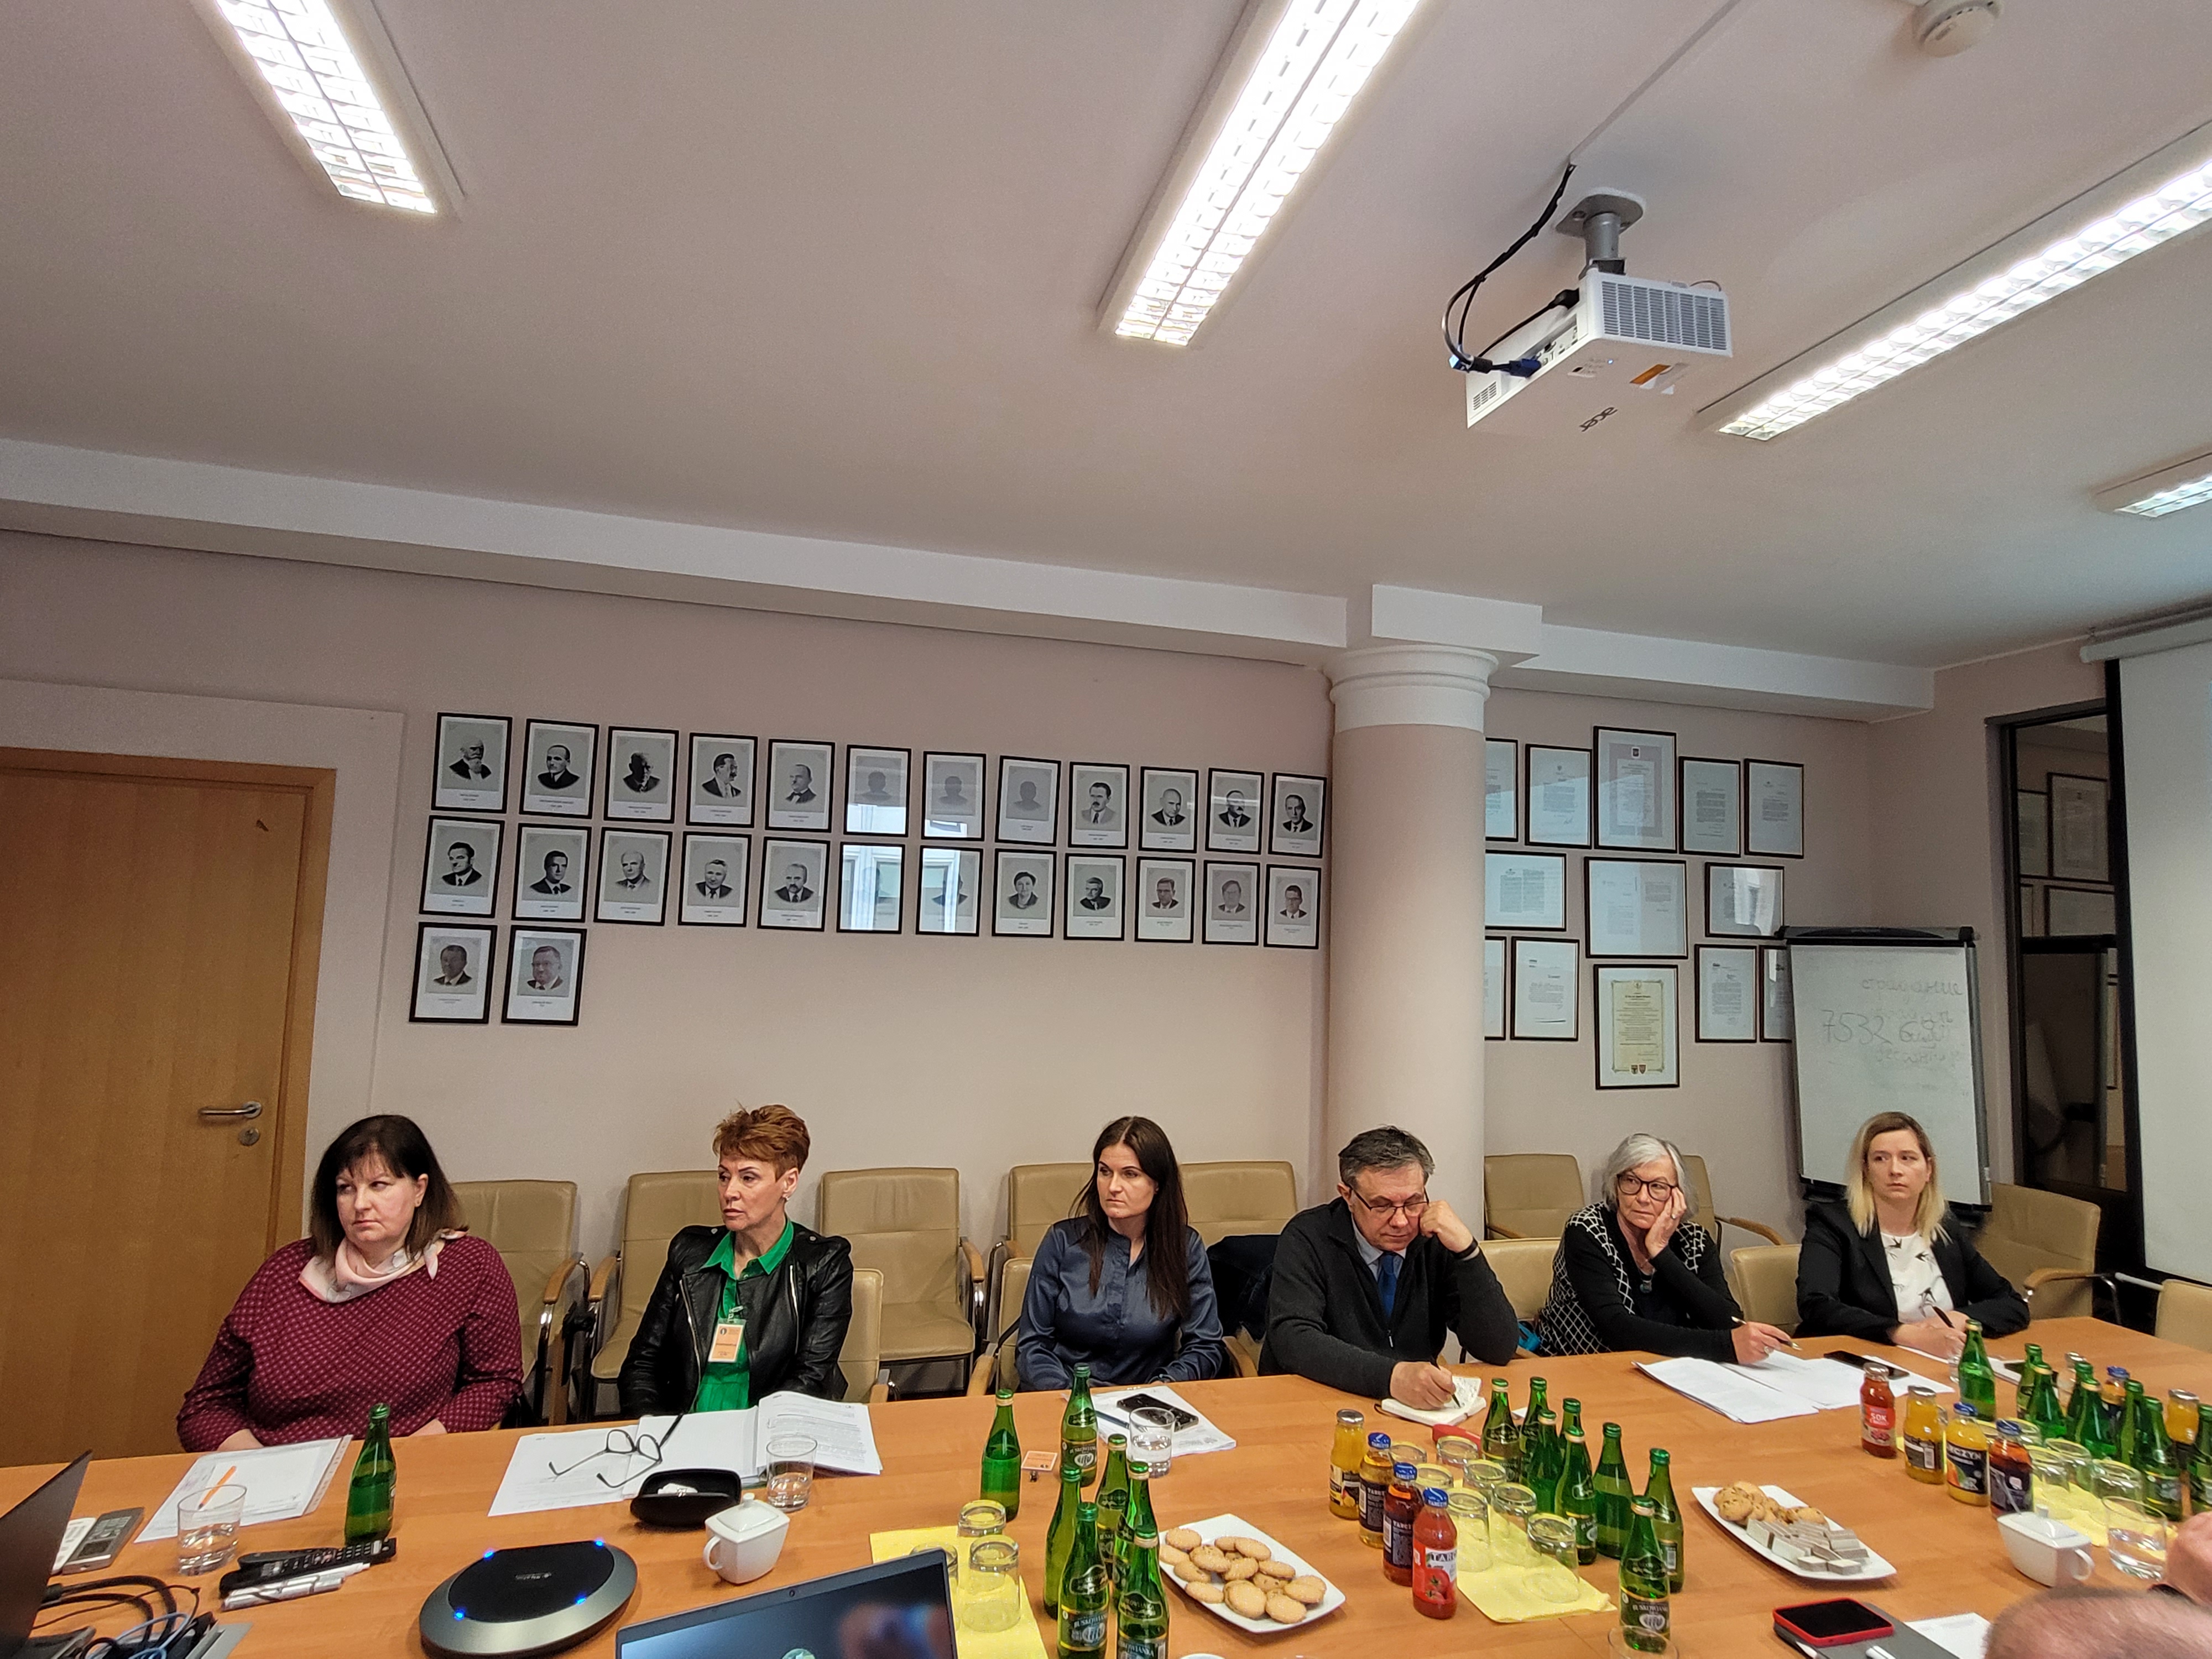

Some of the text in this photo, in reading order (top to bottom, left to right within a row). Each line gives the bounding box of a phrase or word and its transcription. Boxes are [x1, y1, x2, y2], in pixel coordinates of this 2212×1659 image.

[1579, 406, 1618, 432] acer
[1822, 1010, 1892, 1045] 7532
[1870, 1412, 1887, 1422] SOK
[1432, 1552, 1457, 1562] TARC
